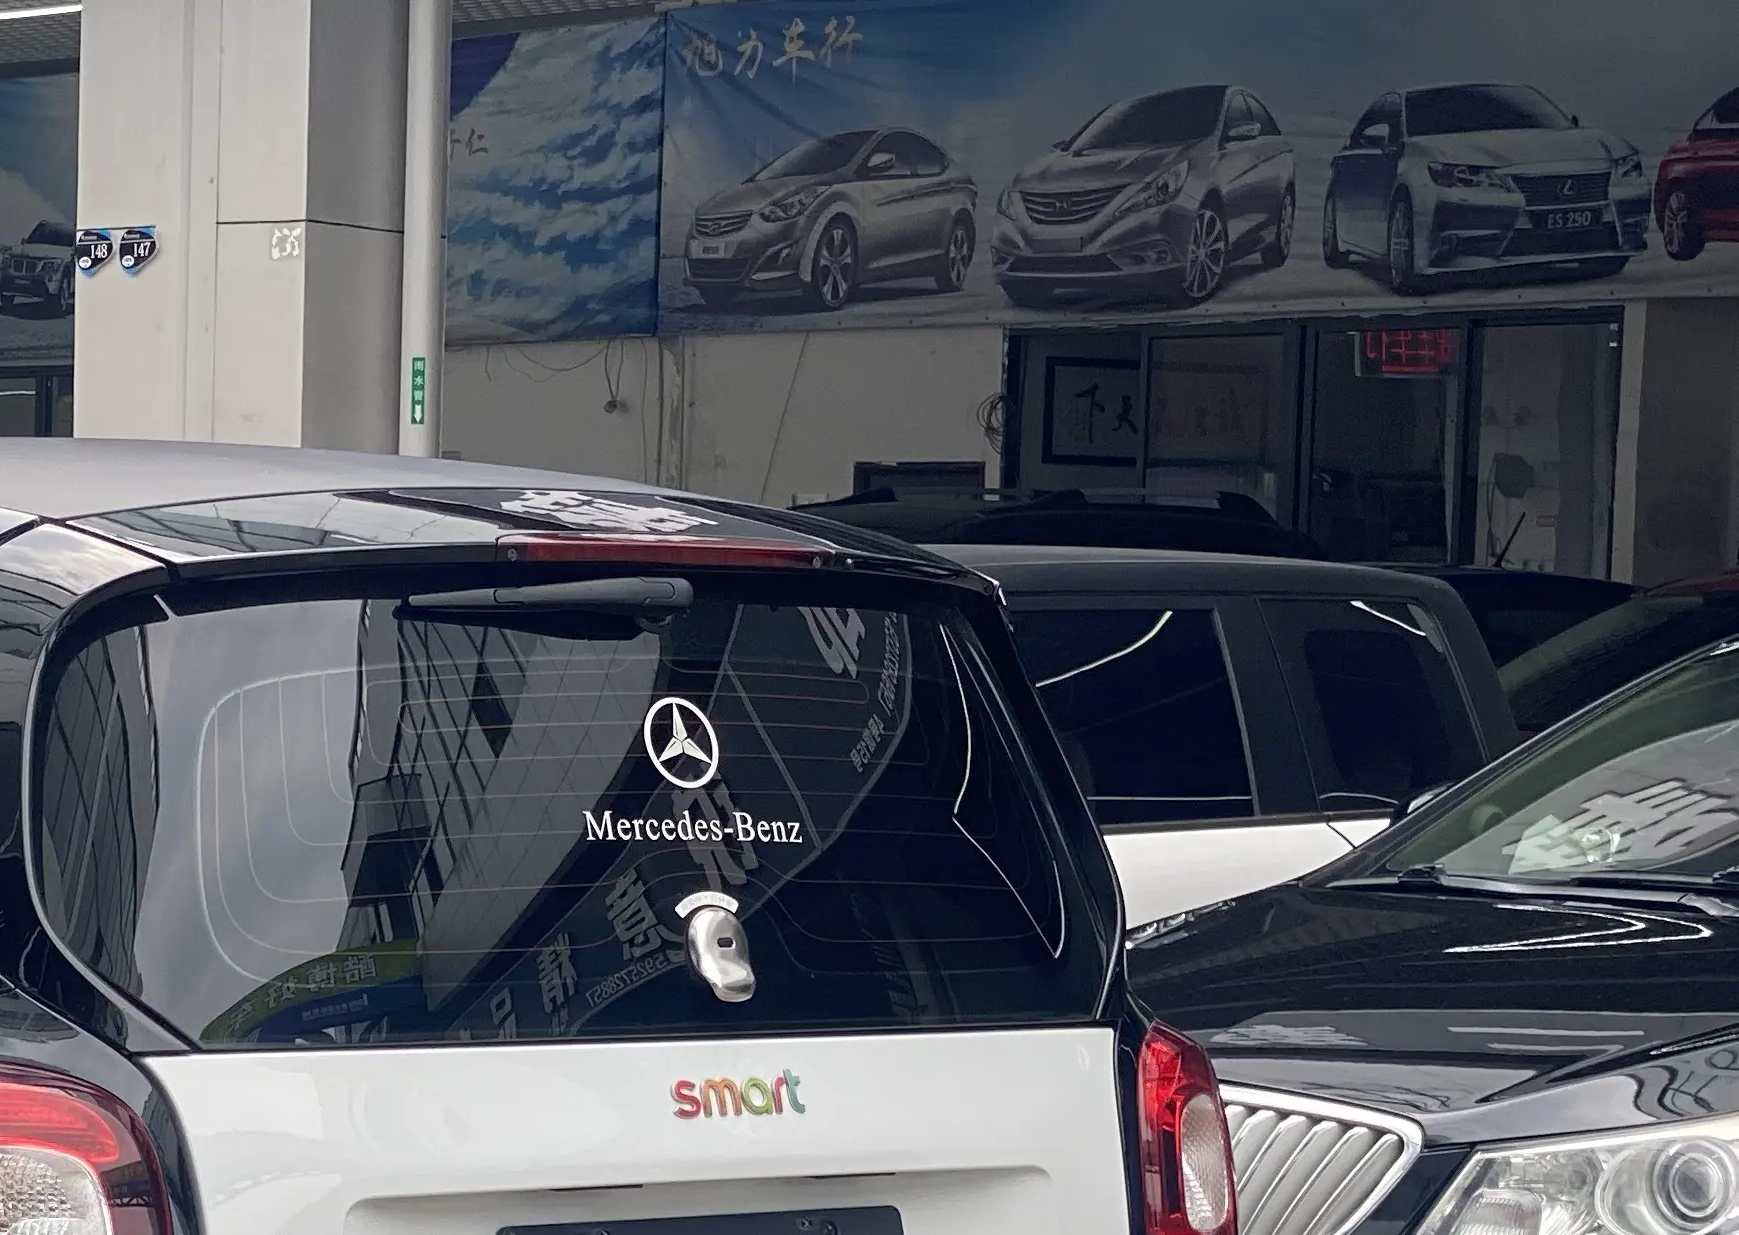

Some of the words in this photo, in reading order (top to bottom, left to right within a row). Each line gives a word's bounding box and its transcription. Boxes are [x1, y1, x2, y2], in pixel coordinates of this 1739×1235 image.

[90, 243, 108, 258] 148
[134, 242, 150, 257] 147
[582, 810, 804, 844] Mercedes-Benz
[670, 1069, 806, 1120] smart
